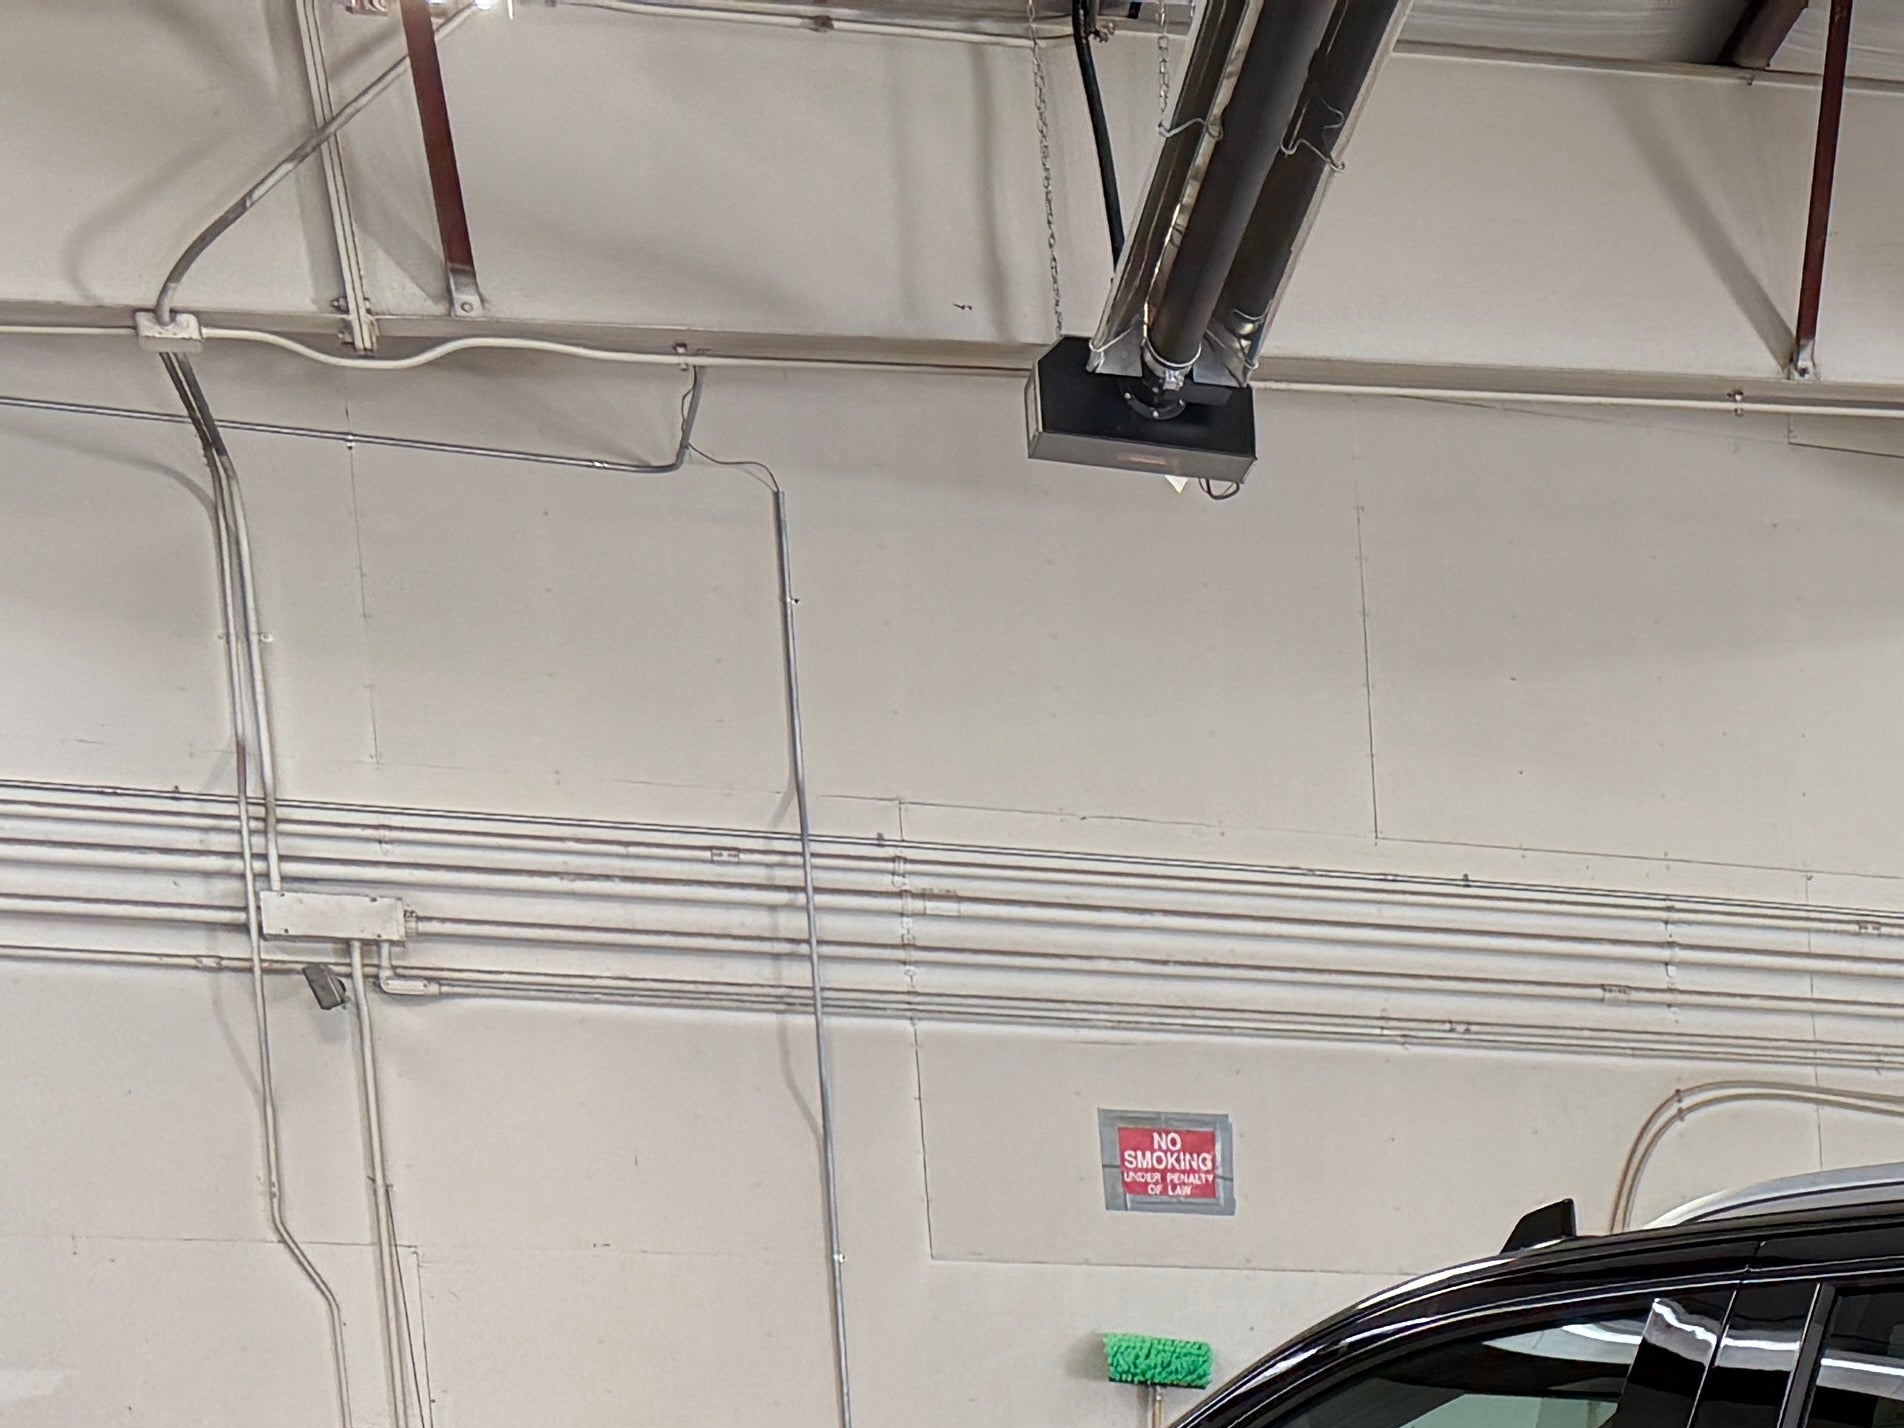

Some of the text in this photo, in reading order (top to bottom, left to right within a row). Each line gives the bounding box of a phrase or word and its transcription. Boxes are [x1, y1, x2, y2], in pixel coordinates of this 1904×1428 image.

[1153, 1132, 1182, 1151] NO
[1124, 1150, 1212, 1170] SMOKING
[1124, 1171, 1214, 1184] UNDER PENALTY
[1148, 1184, 1192, 1196] OF LAW
